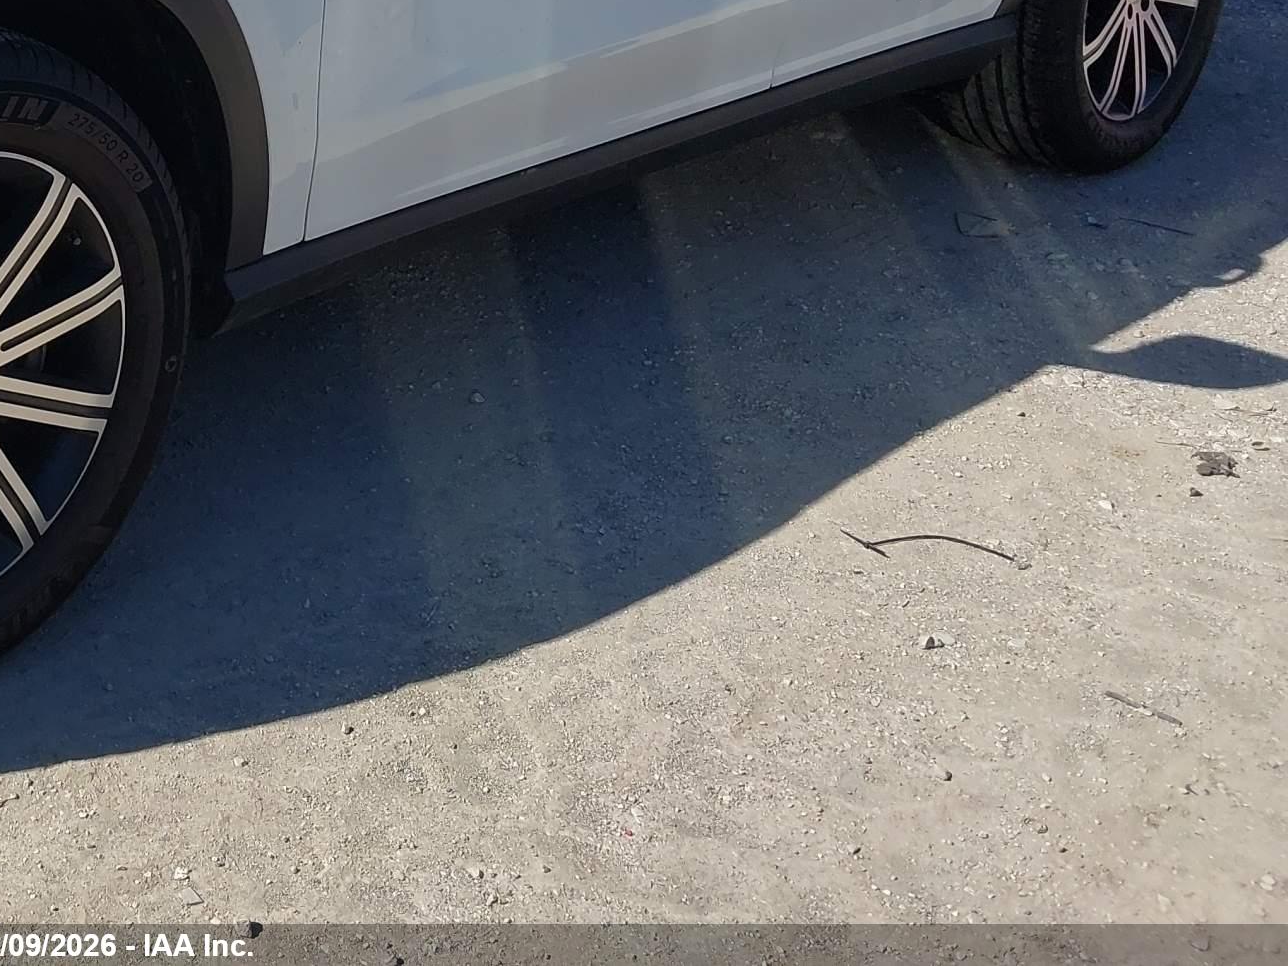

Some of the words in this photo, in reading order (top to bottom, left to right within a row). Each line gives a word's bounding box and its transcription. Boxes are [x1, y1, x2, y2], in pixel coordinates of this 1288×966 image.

[67, 112, 118, 151] 275/50
[118, 152, 130, 164] R
[124, 165, 146, 183] 20
